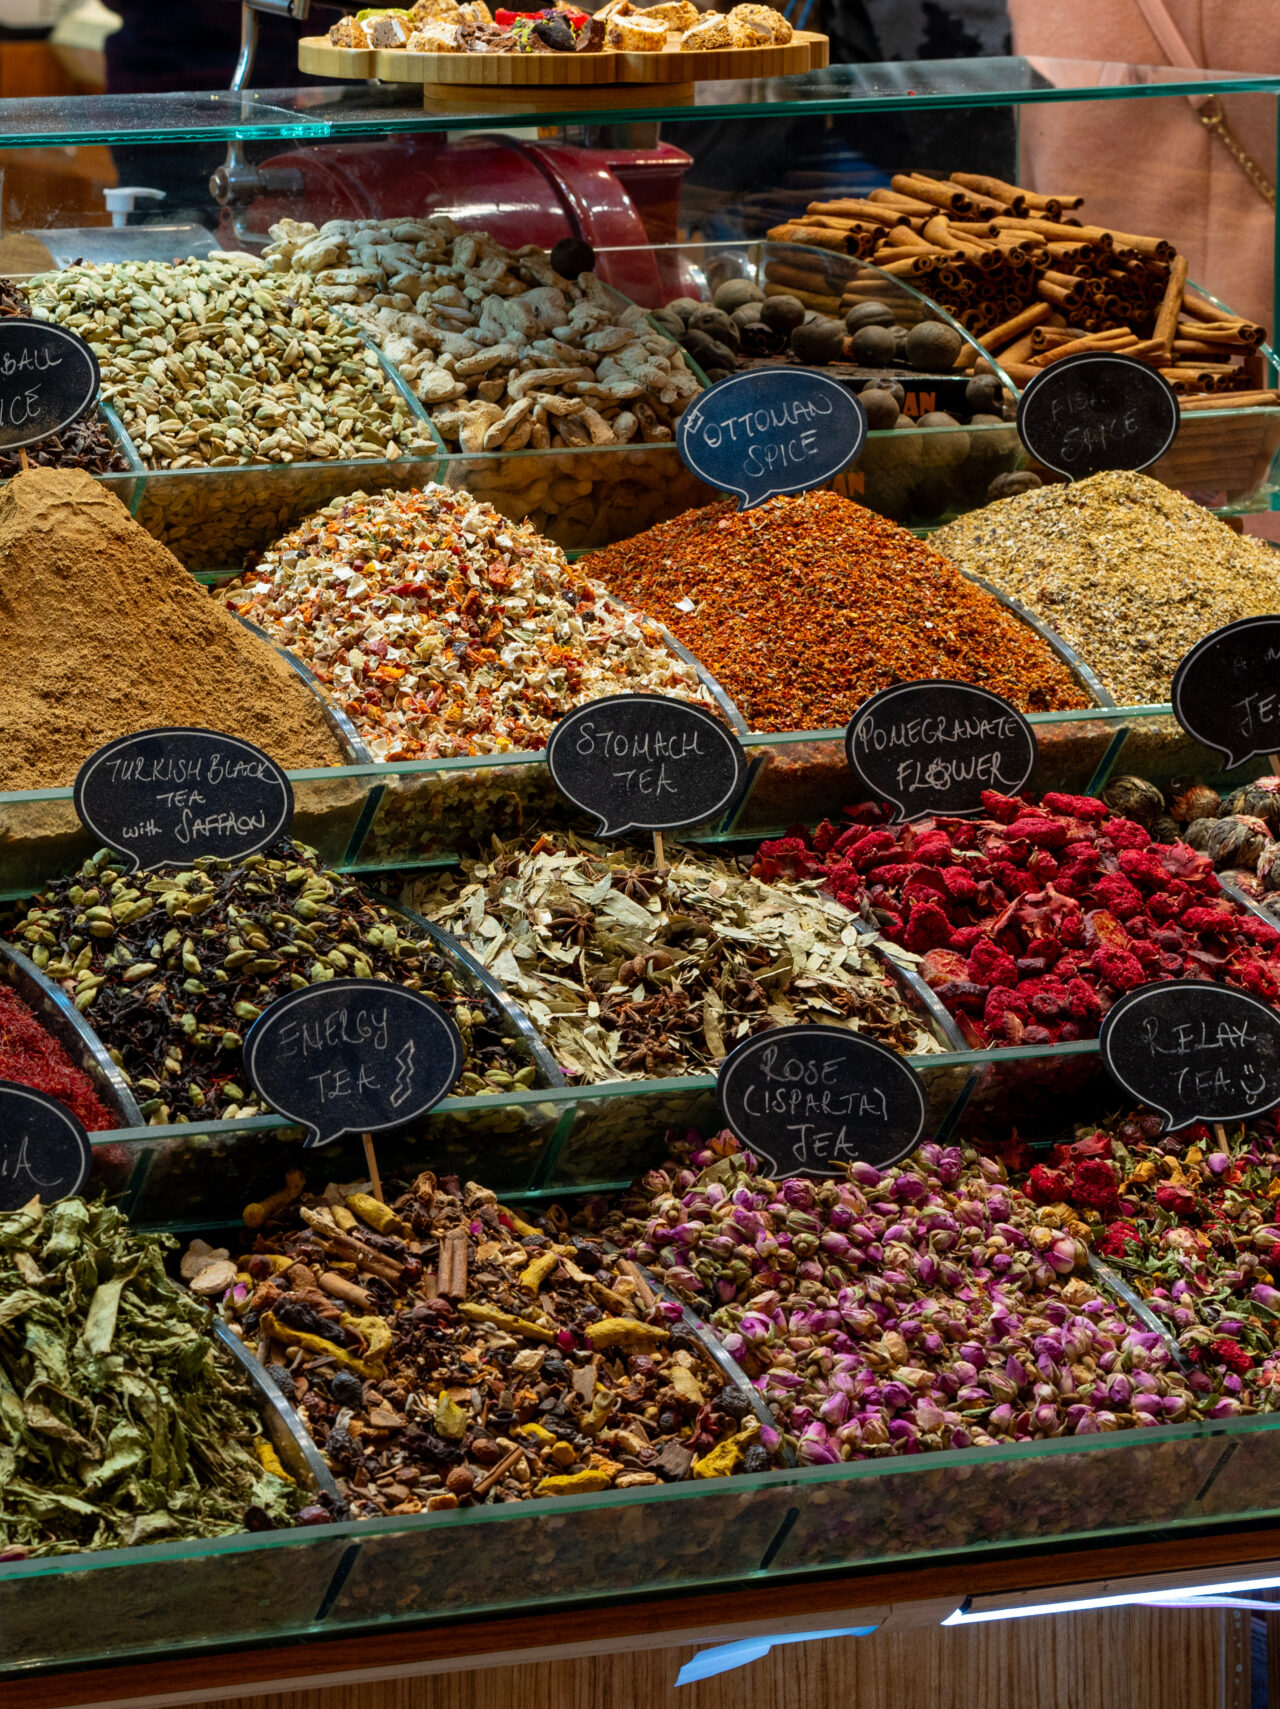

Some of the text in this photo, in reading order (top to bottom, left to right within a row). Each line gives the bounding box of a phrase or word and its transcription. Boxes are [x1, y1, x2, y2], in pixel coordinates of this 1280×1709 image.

[703, 393, 833, 448] OTTOMAN
[744, 429, 820, 478] SPICE
[857, 715, 1020, 754] POMEGRANATE
[1232, 692, 1280, 738] TE
[576, 722, 705, 762] STOMACH
[106, 752, 282, 785] TURKISH BLACK
[612, 762, 678, 796] TEA
[896, 751, 1022, 793] FLOWER
[156, 788, 206, 808] TEA
[122, 808, 266, 844] with SAFFRON
[275, 1008, 388, 1062] ENERGY
[1142, 1016, 1257, 1058] RELAX
[308, 1063, 381, 1104] TEA
[760, 1044, 847, 1085] ROSE
[786, 1123, 859, 1162] TEA
